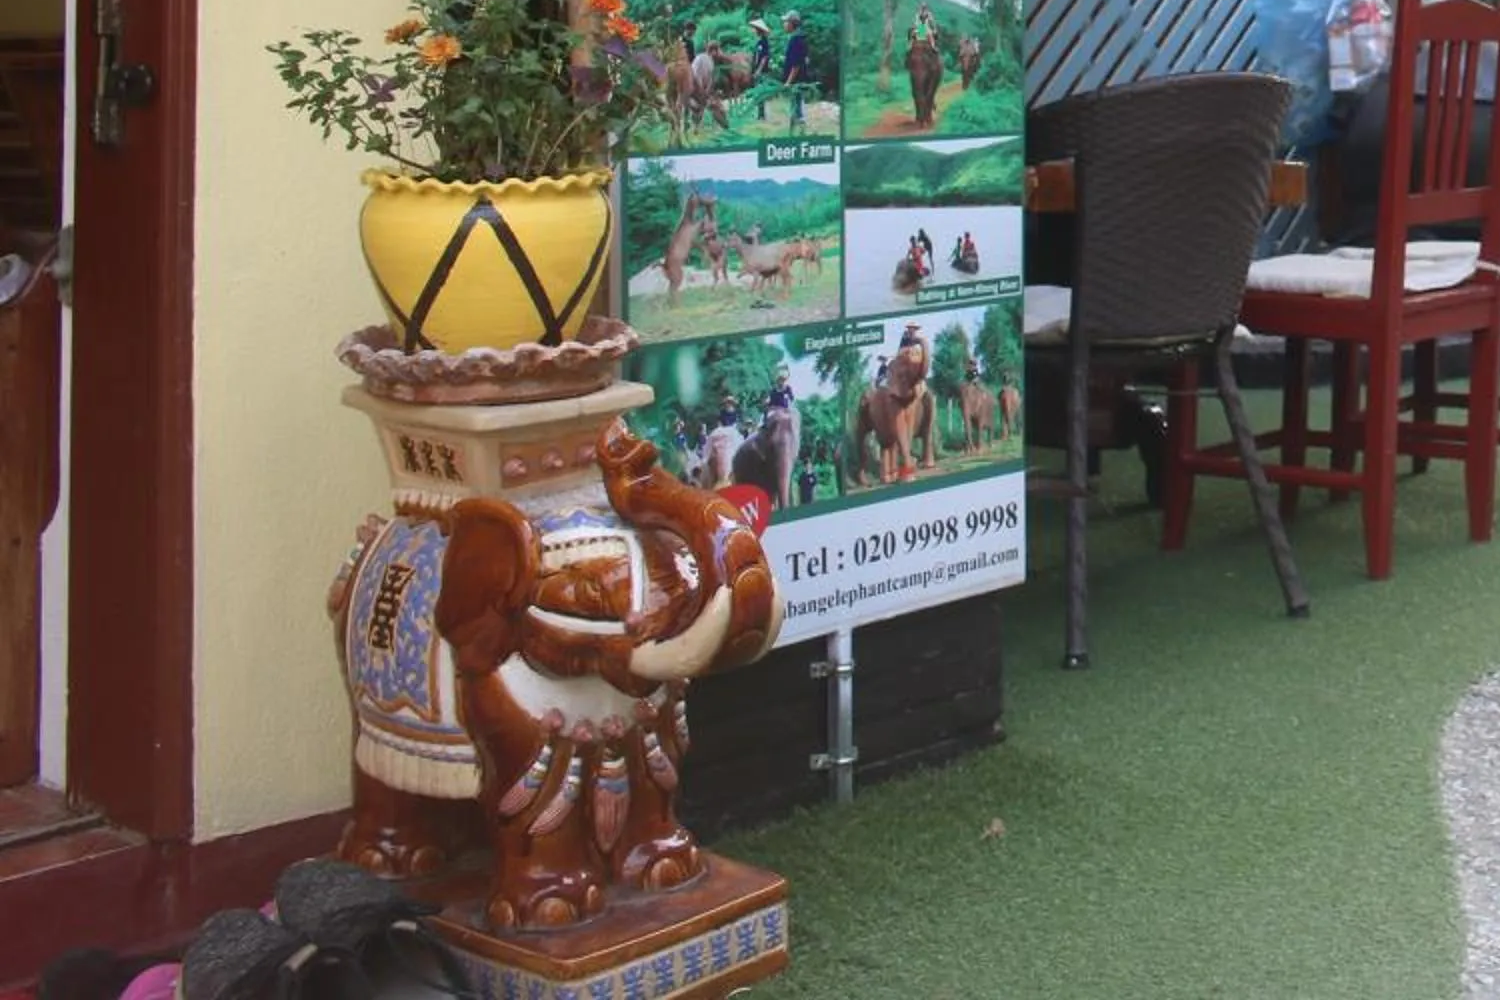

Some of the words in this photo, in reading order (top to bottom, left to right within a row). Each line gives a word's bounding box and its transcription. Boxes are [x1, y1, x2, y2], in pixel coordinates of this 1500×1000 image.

[767, 143, 797, 161] Deer
[801, 141, 833, 159] Farm
[805, 334, 843, 352] Elephant
[785, 547, 828, 582] Tel
[854, 530, 896, 566] 020
[904, 517, 958, 553] 9998
[965, 501, 1018, 536] 9998
